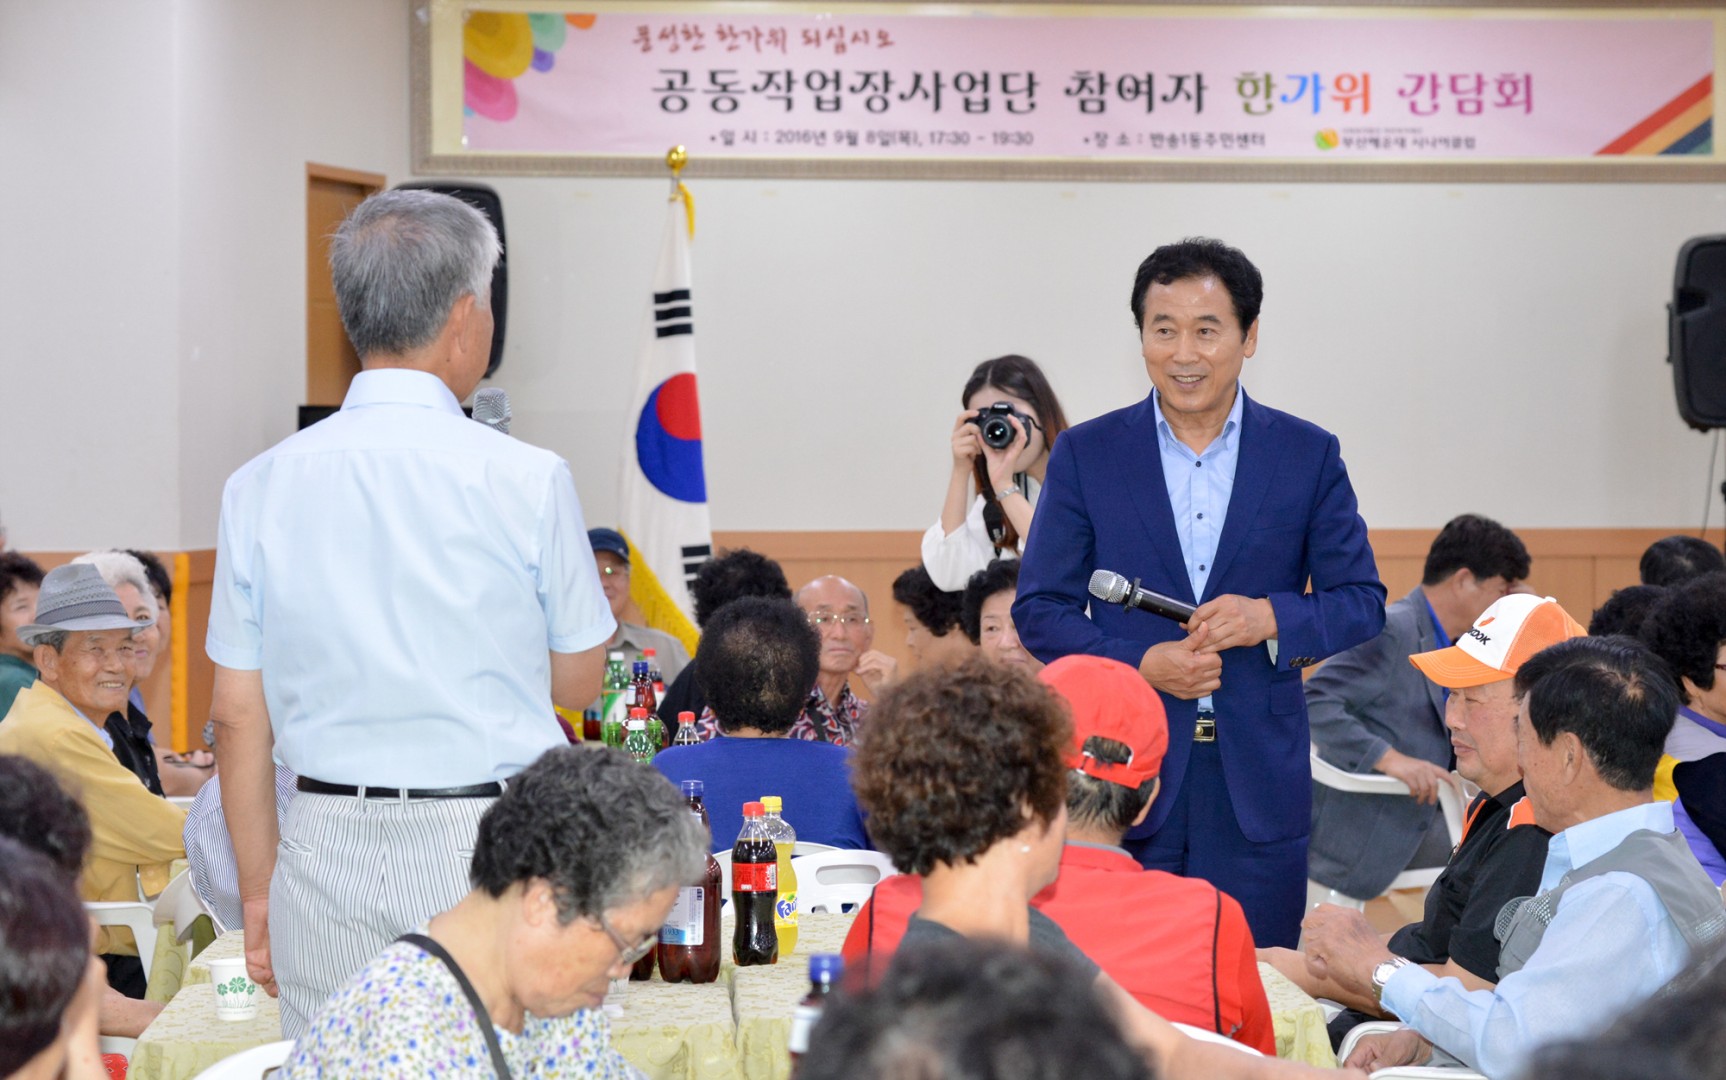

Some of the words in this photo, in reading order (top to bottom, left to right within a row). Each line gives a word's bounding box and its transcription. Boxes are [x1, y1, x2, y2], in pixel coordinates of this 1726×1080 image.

[633, 24, 705, 53] 풍성한
[715, 24, 788, 54] 한가위
[652, 69, 1040, 115] 공동작업장사업단
[1064, 70, 1208, 115] 참여자
[1235, 72, 1371, 116] 한가위
[1398, 72, 1534, 116] 간담회
[719, 130, 735, 147] 일
[742, 131, 757, 145] 시
[775, 130, 827, 146] 2016년
[834, 130, 859, 147] 9월
[929, 131, 971, 145] 17:30
[992, 131, 1034, 146] 19:30
[1094, 131, 1109, 148] 장
[1116, 132, 1130, 146] 소
